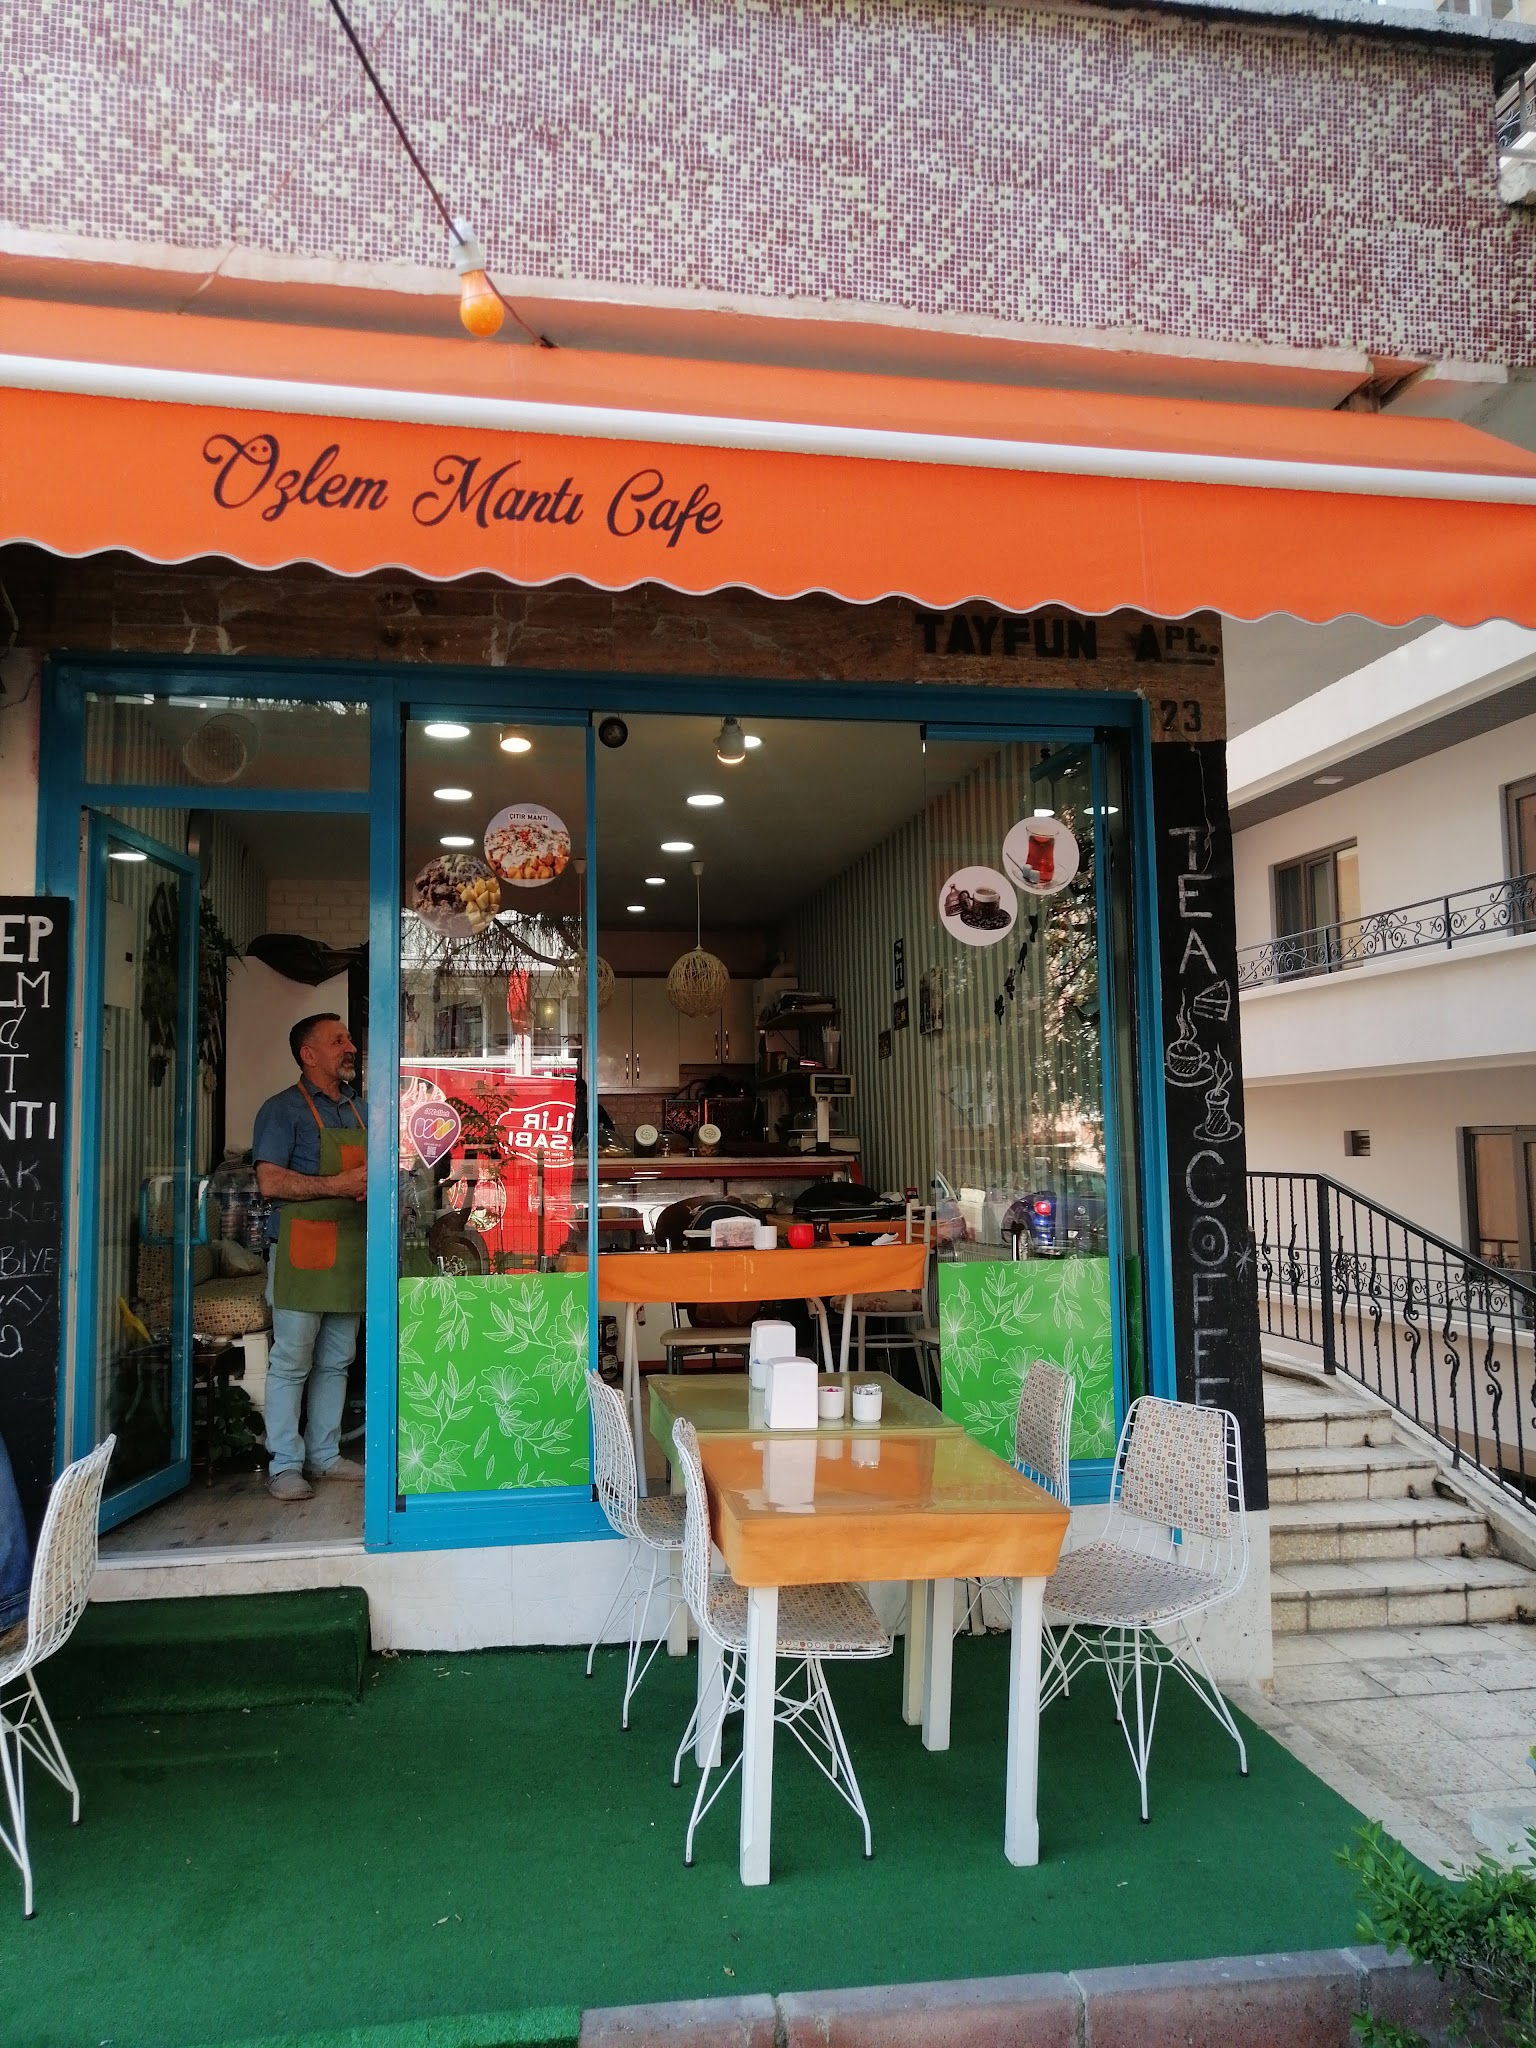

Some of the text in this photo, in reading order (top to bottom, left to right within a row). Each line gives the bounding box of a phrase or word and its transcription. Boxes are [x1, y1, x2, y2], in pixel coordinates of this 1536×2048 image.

[606, 468, 724, 548] Cafe
[914, 613, 1098, 661] TAYFUN
[1160, 700, 1202, 733] 23
[1168, 826, 1217, 974] TEA
